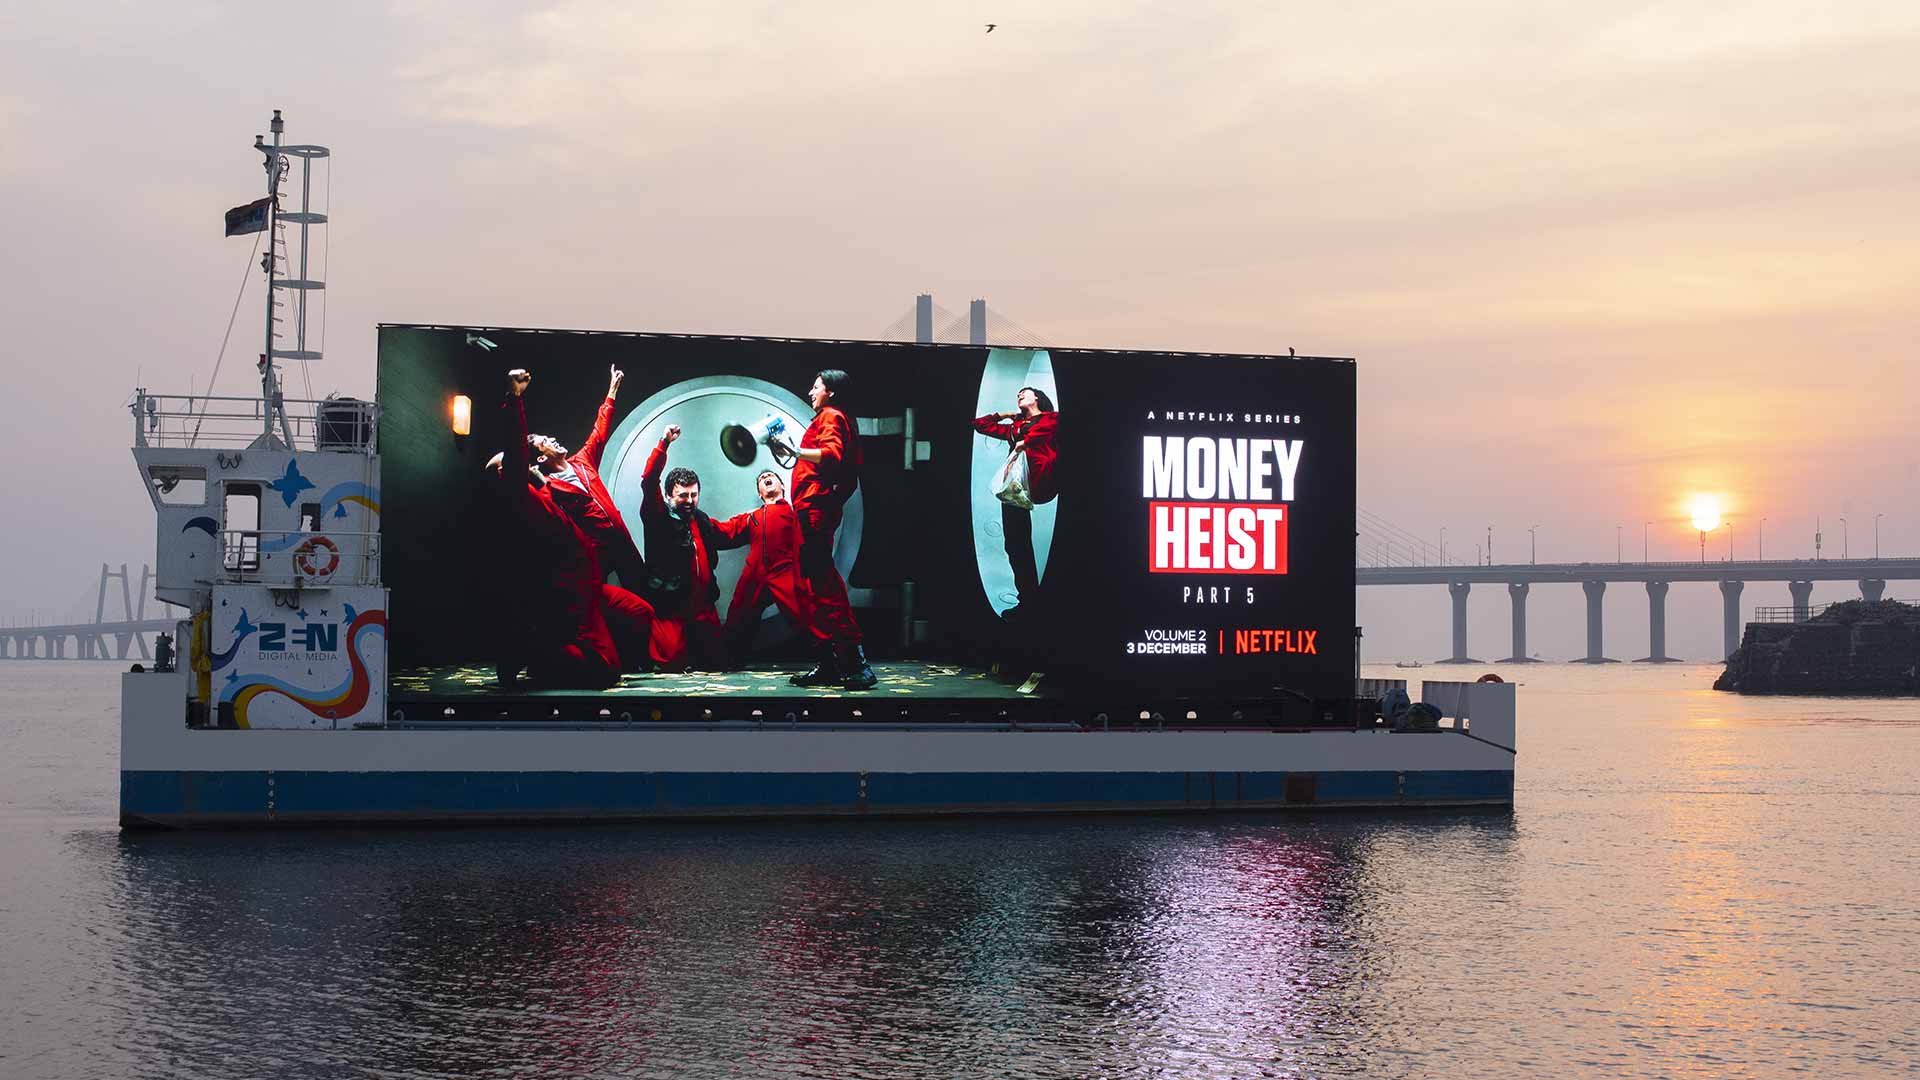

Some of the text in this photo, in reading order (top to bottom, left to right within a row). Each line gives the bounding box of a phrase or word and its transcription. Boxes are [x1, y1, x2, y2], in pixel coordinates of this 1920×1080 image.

[1147, 410, 1301, 424] A NETFLIX SERIES
[1142, 435, 1304, 501] MONEY
[1155, 506, 1283, 570] HEIST
[1183, 586, 1254, 604] PART 5
[1144, 629, 1207, 642] VOLUME 2
[1235, 630, 1318, 655] NETFLIX
[1126, 642, 1207, 655] 3 DECEMBER
[258, 652, 338, 662] DIGITAL MEDIA
